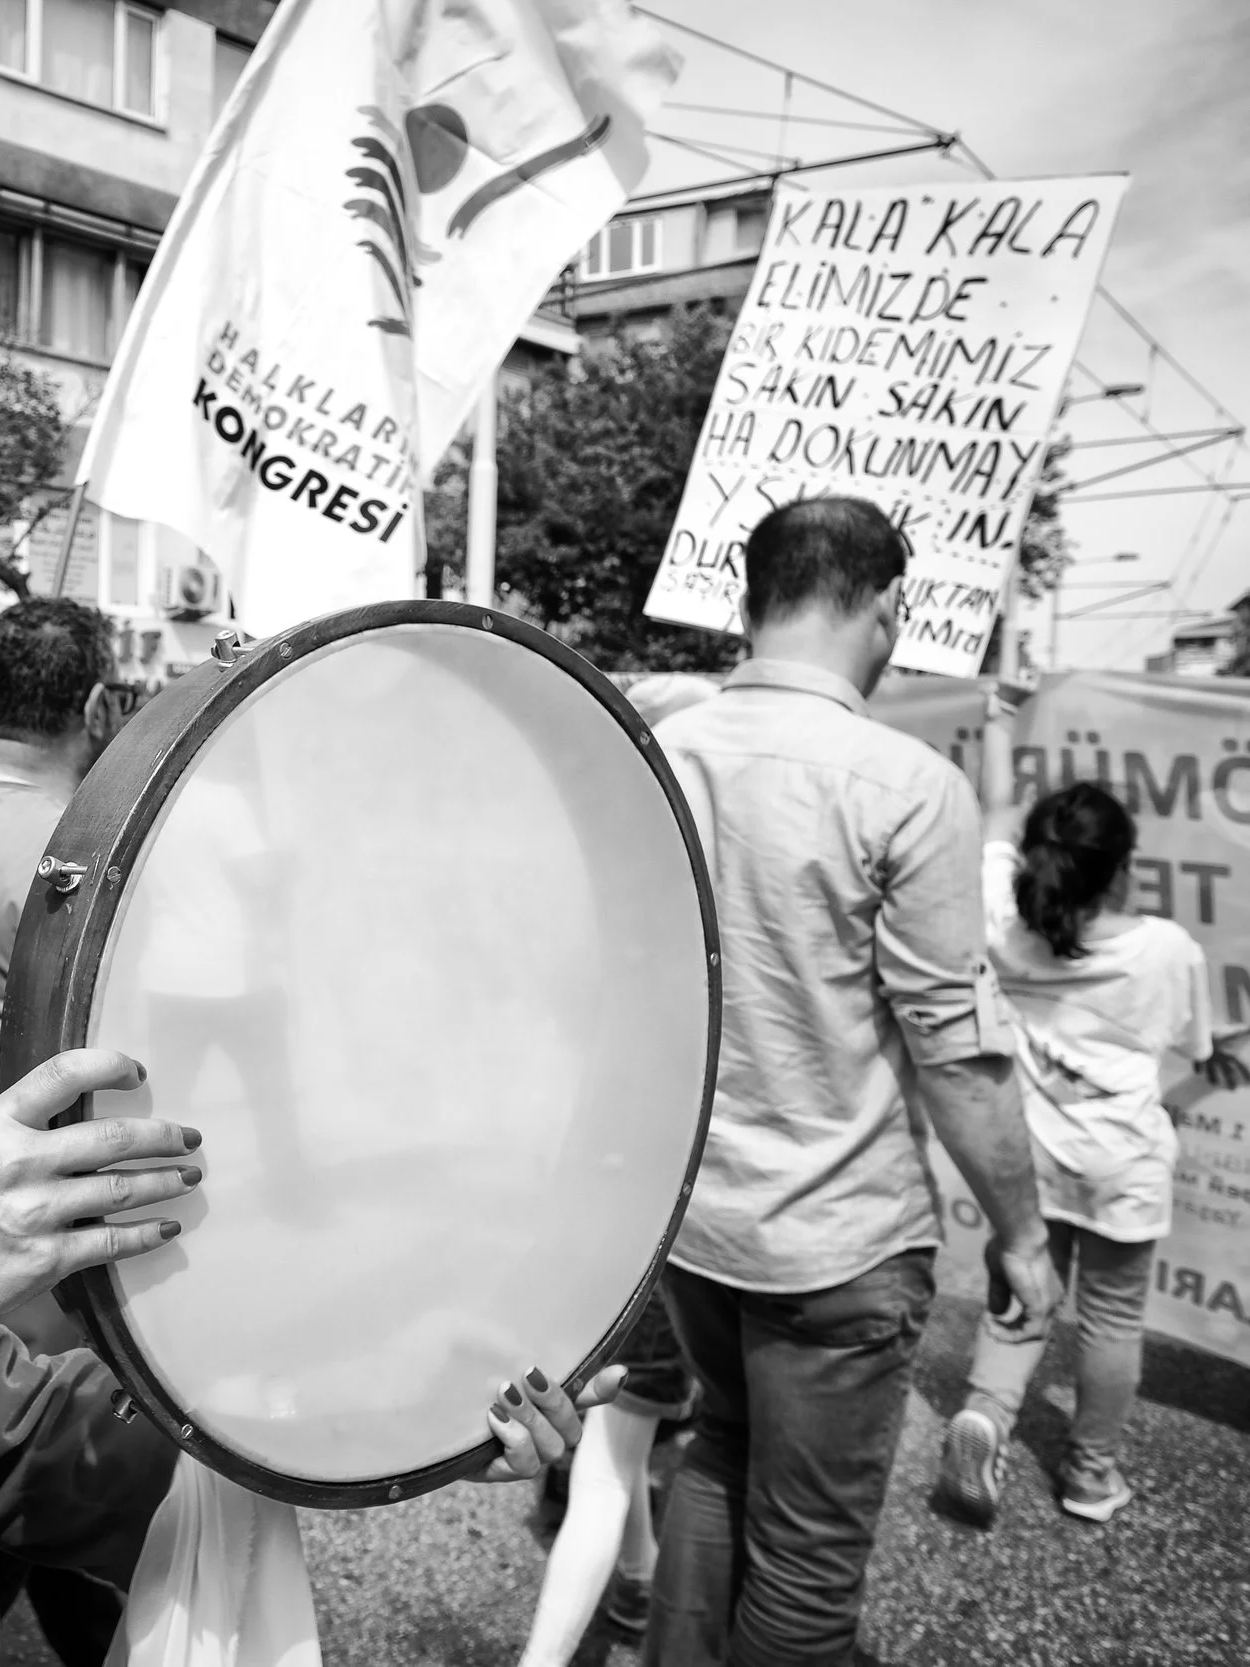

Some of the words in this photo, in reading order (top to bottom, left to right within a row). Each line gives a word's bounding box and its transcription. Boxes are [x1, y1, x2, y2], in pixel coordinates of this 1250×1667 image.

[776, 198, 908, 254] KALA
[925, 195, 1101, 259] KALA
[724, 361, 857, 409] SAKIN
[877, 380, 1030, 432] SAKIN
[192, 377, 409, 544] KONGRESİ
[702, 410, 756, 458] HA
